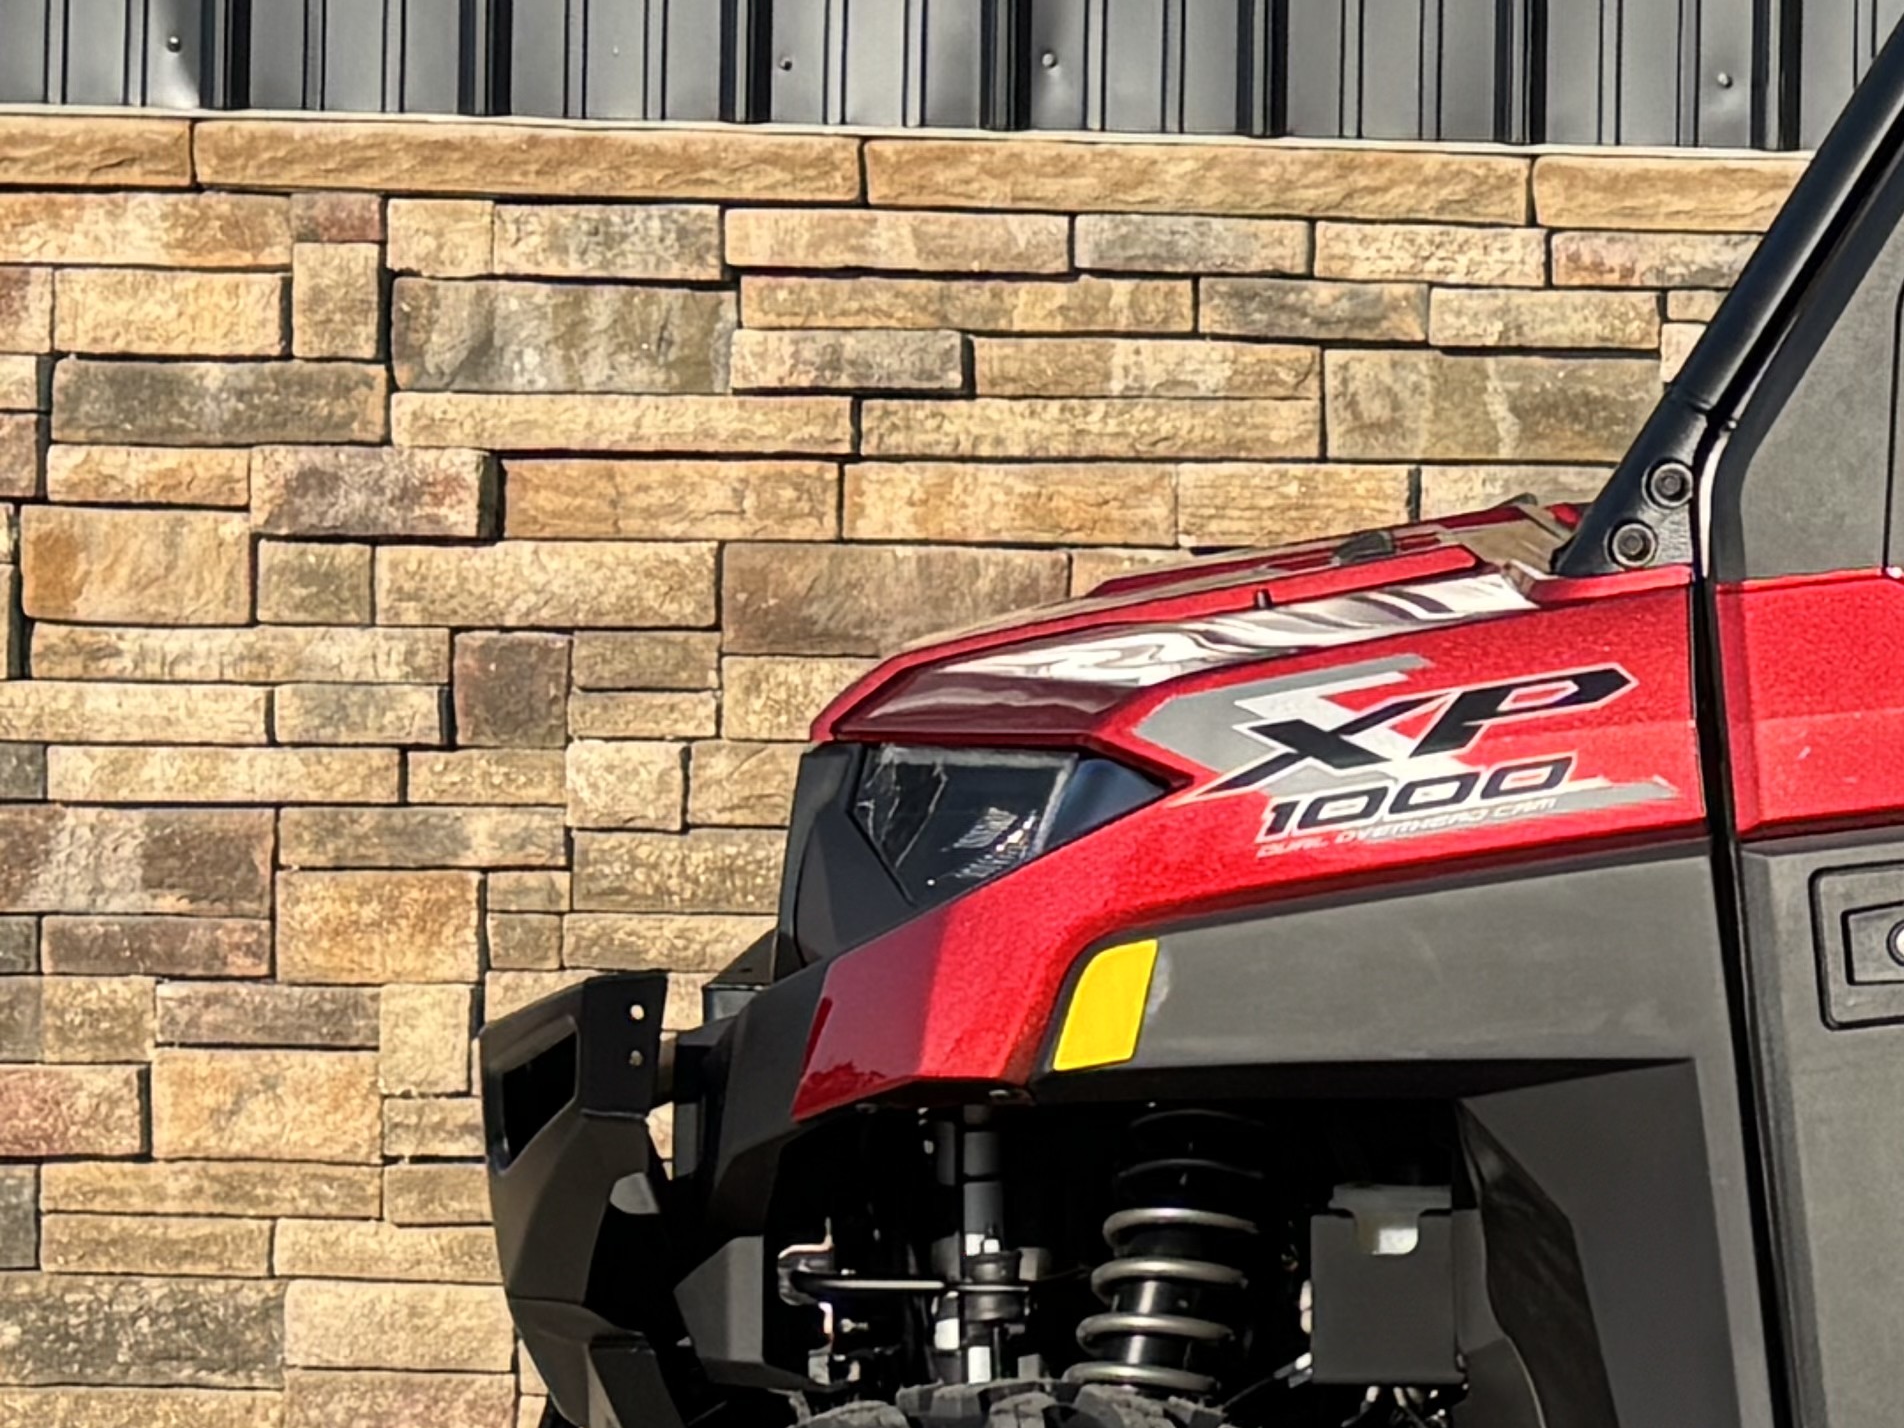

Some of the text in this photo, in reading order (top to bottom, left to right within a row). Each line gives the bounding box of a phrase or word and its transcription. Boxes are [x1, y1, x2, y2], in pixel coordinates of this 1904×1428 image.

[1194, 665, 1635, 797] XP
[1255, 796, 1558, 860] DUAL OVERHEAD CAM
[1261, 755, 1574, 839] 1000
